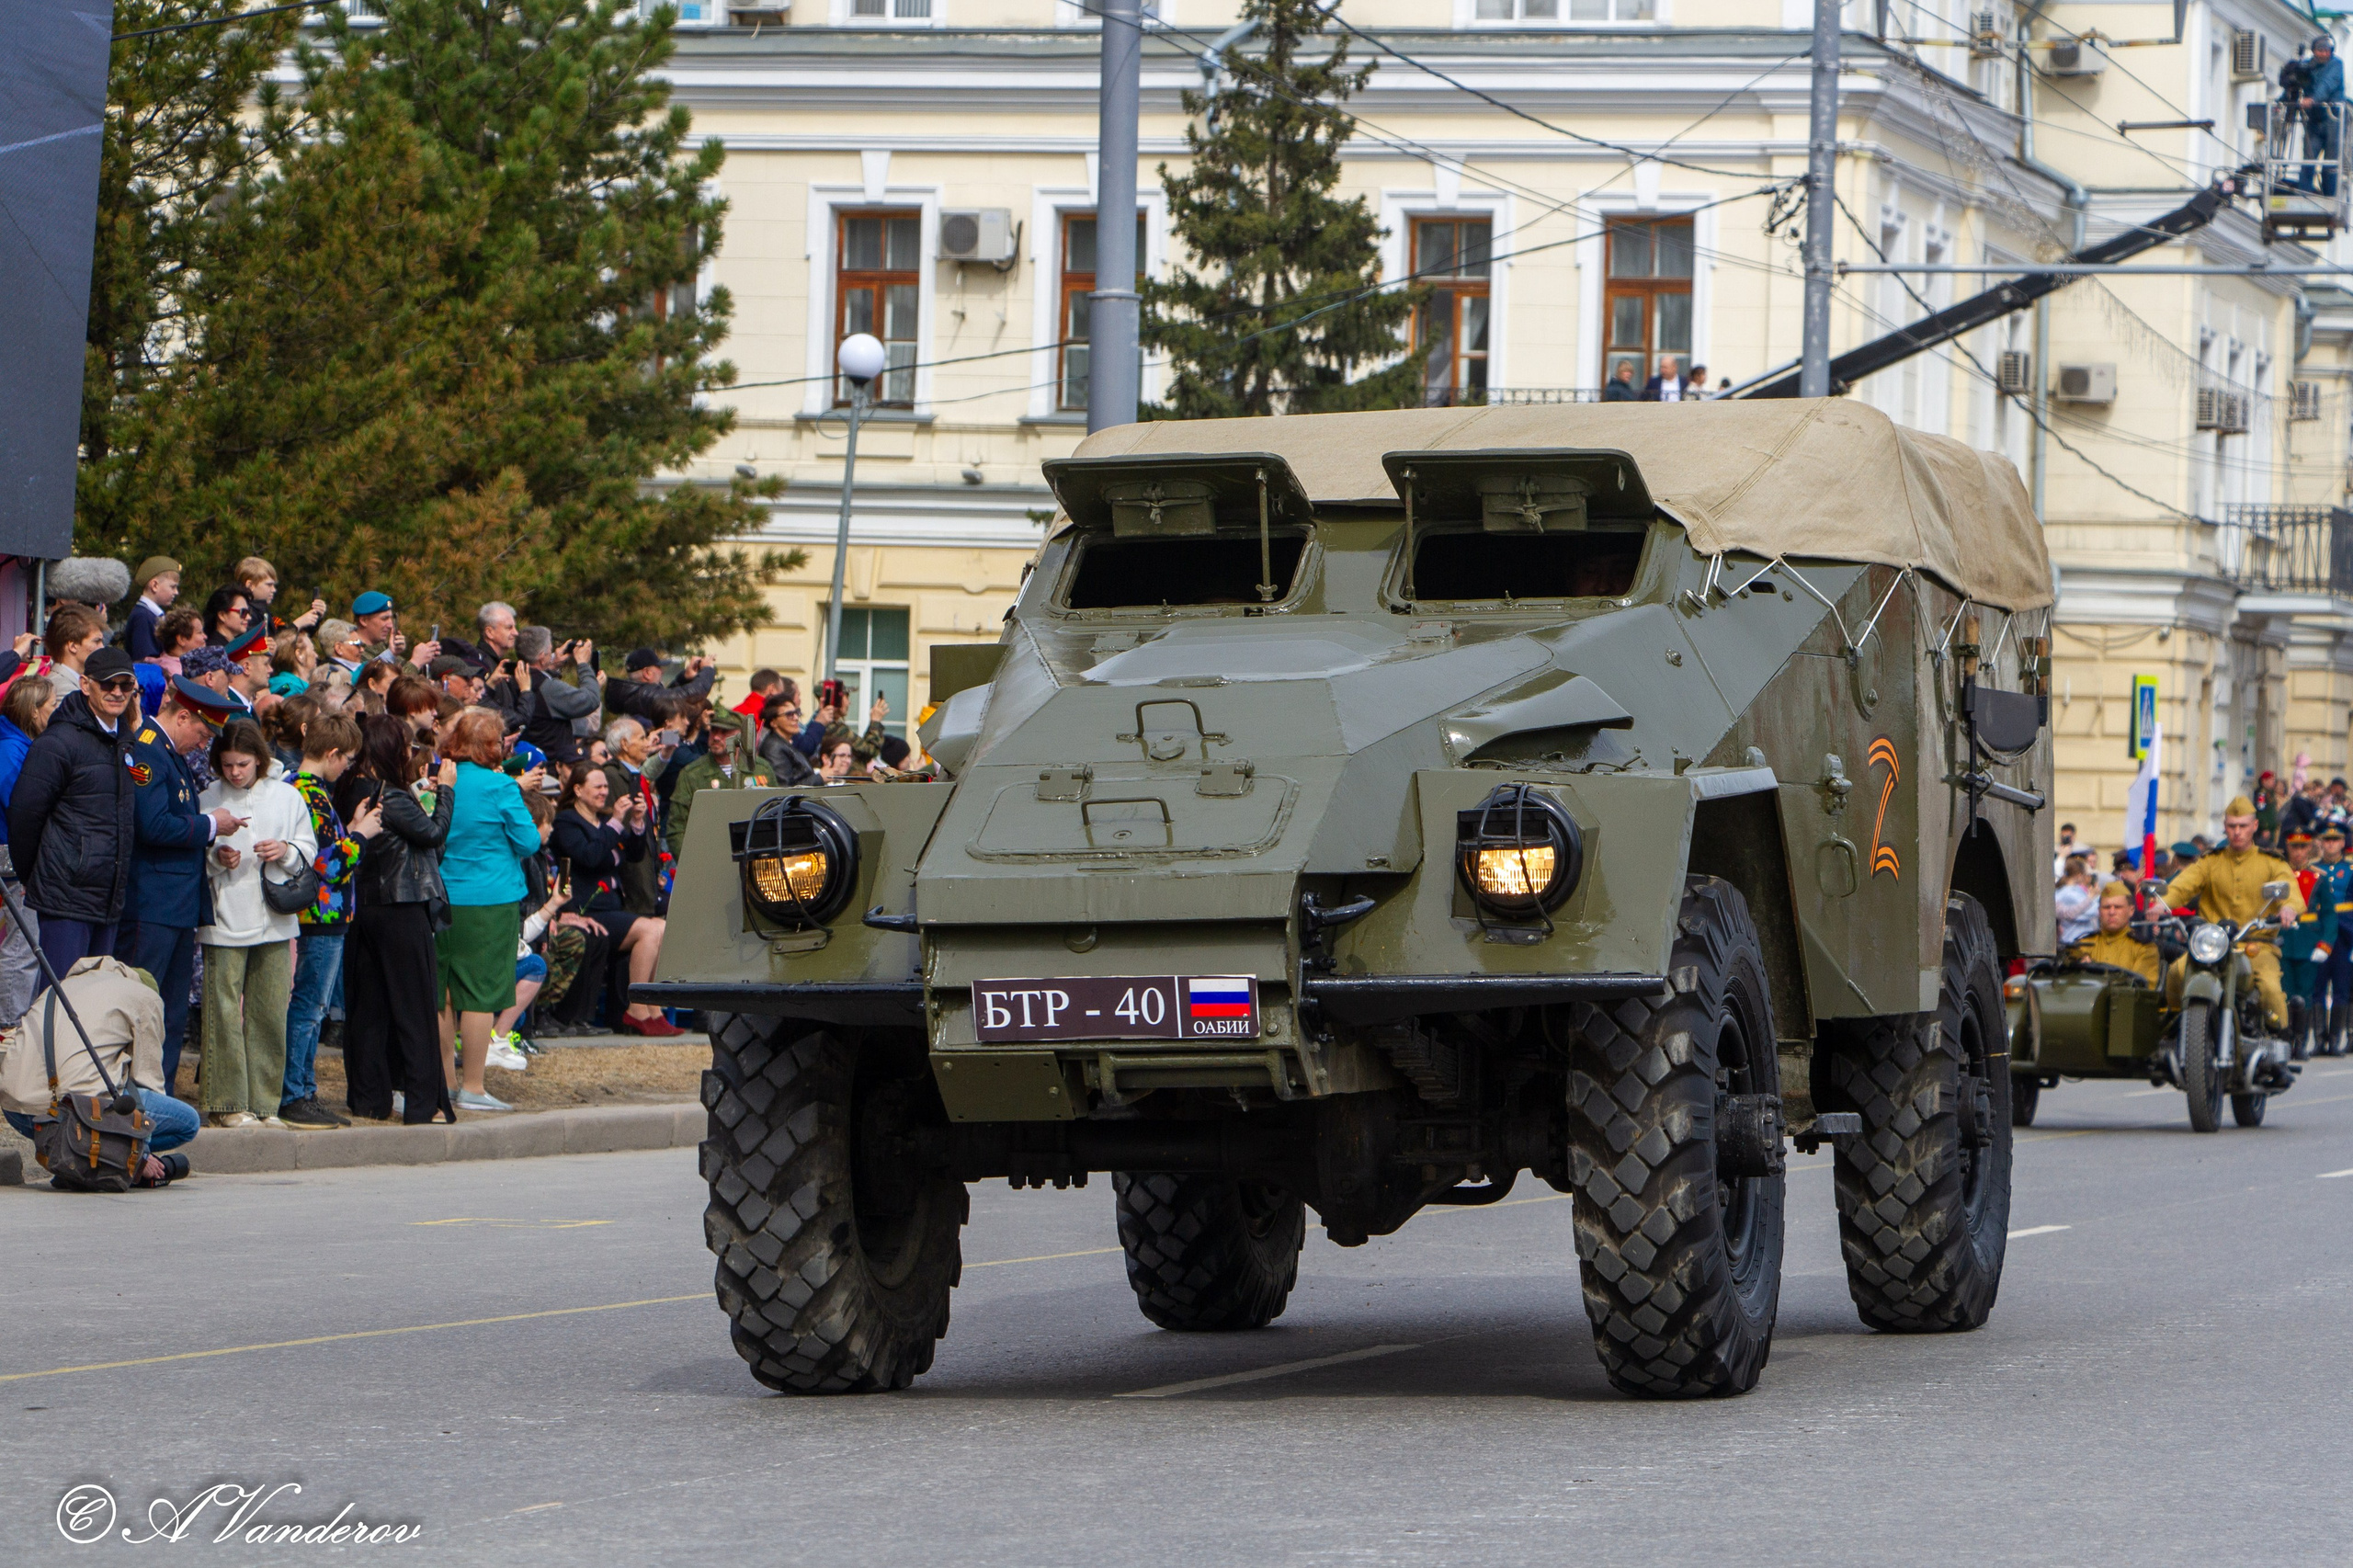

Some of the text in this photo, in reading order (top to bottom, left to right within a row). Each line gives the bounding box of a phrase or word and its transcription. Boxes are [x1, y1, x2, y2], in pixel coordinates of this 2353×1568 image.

[981, 990, 1070, 1028] БТР
[1115, 987, 1165, 1026] 40
[1193, 1020, 1250, 1034] ОАБИИ
